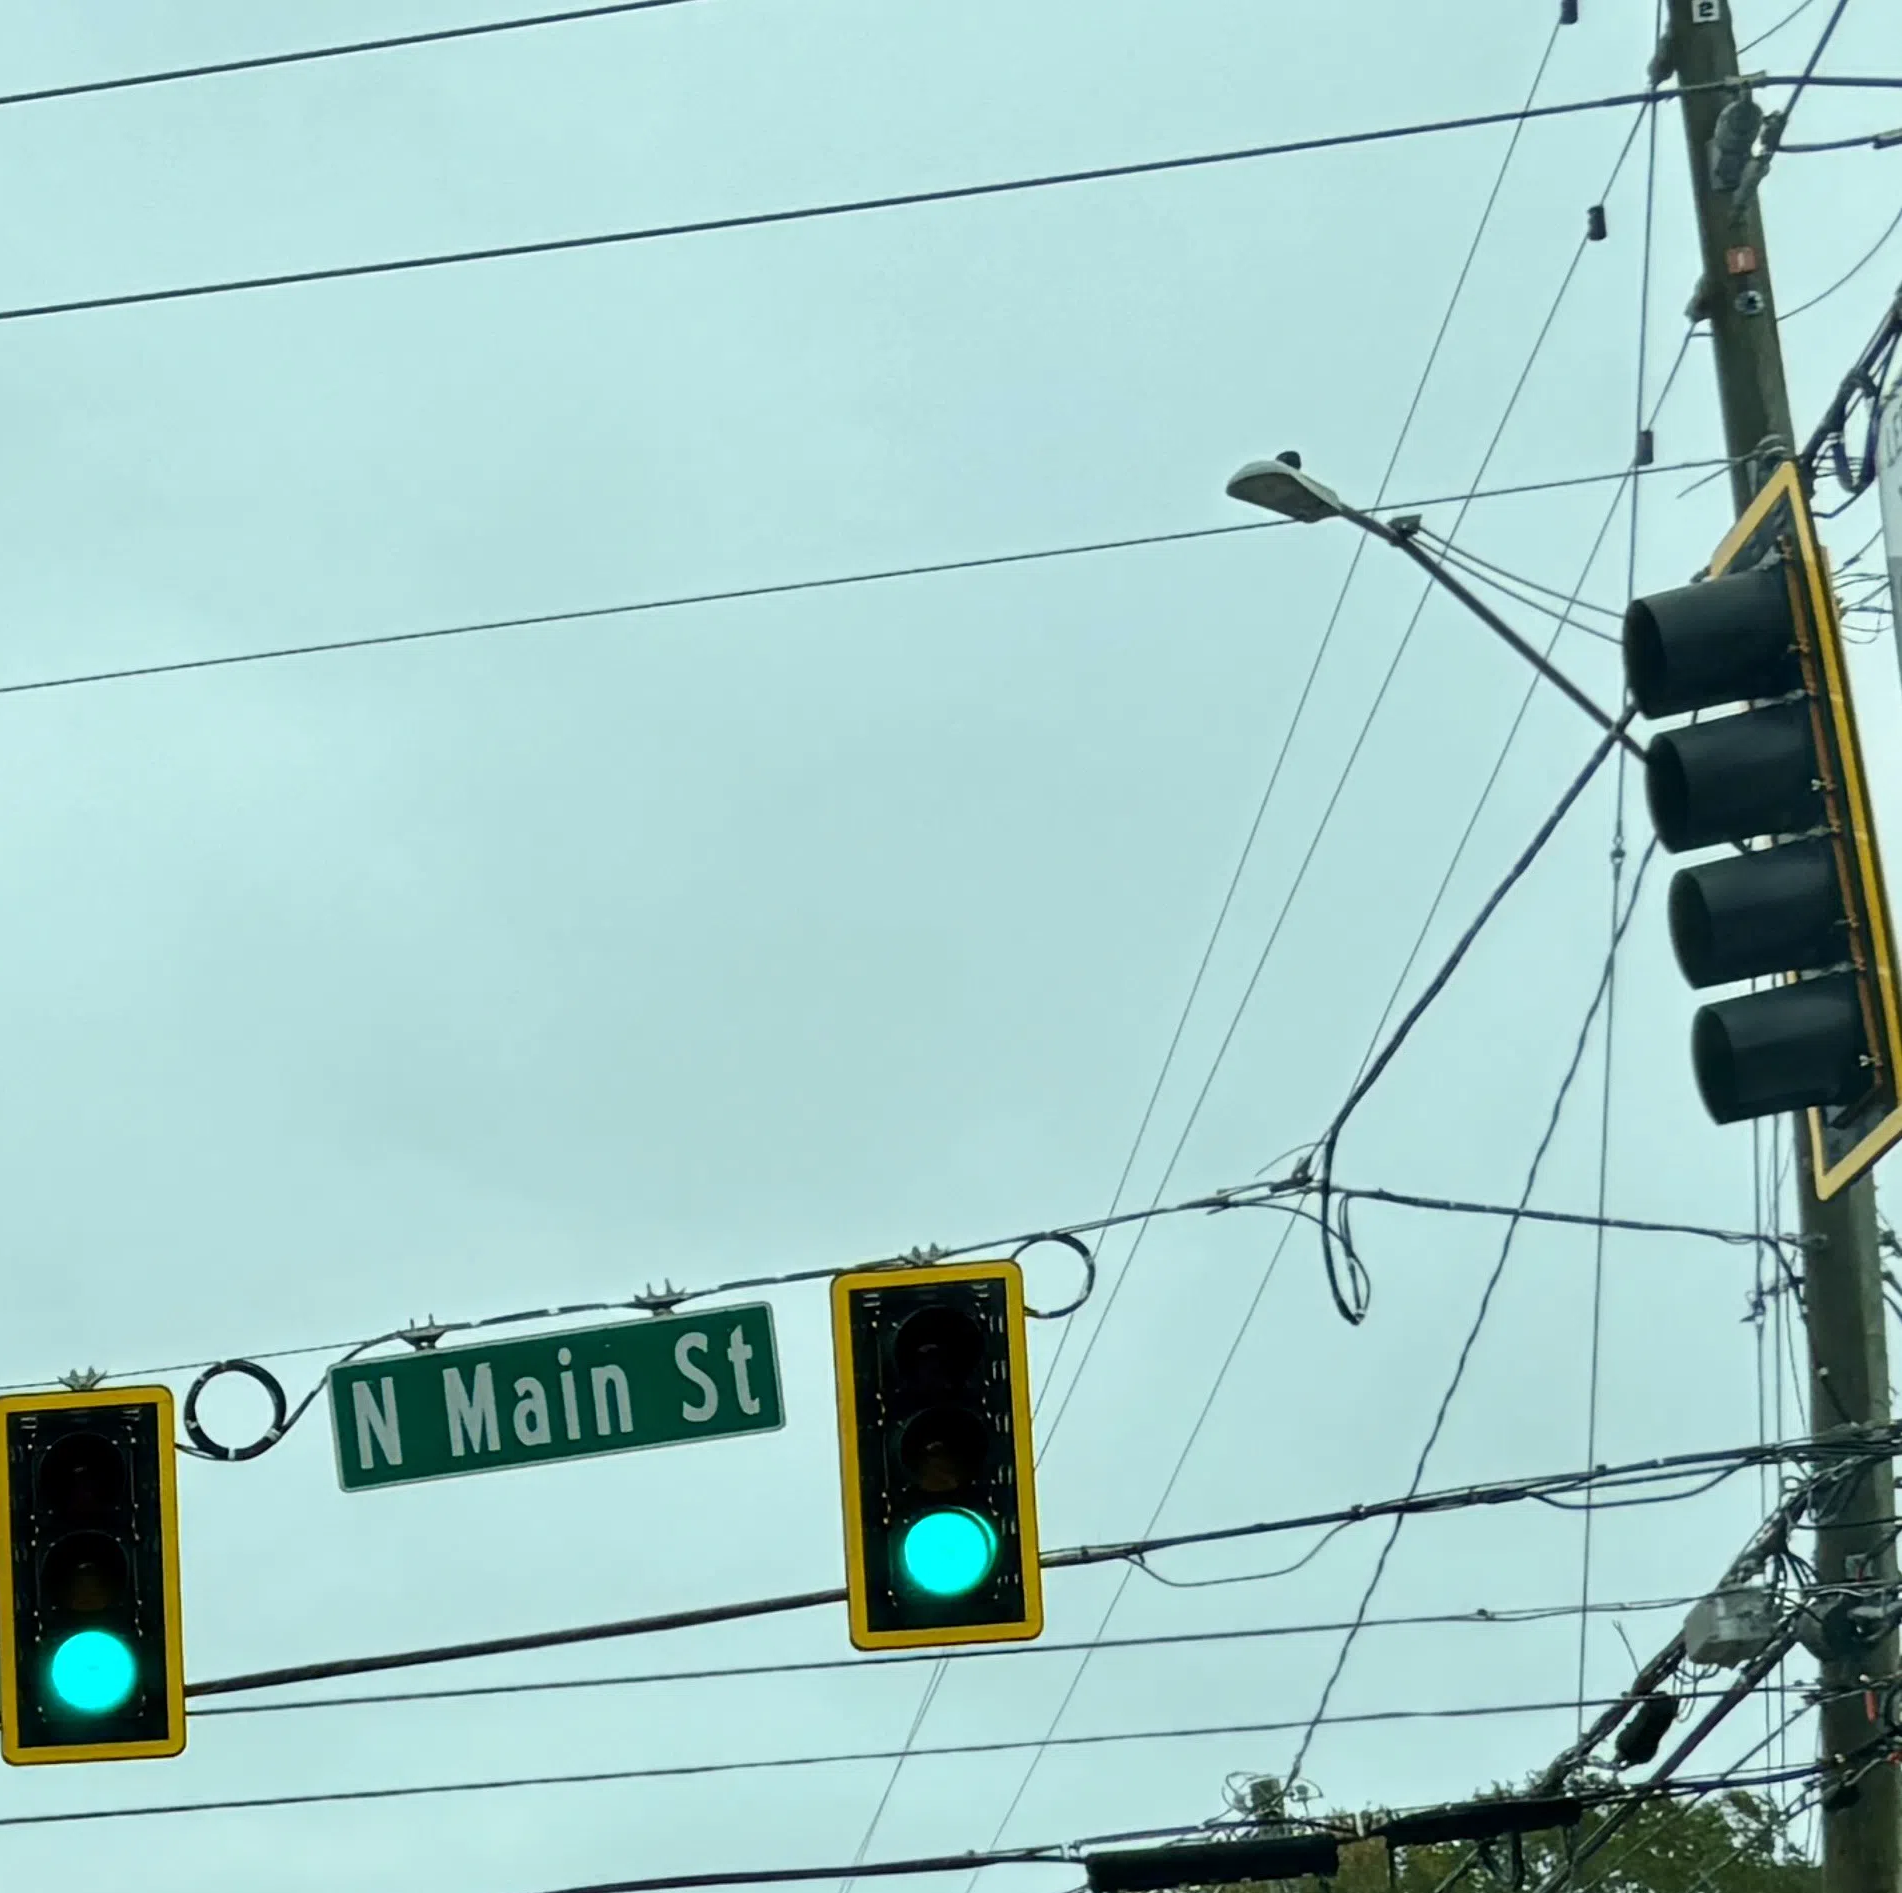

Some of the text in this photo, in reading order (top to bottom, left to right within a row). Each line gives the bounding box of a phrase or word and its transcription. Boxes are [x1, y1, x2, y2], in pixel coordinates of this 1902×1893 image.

[352, 1324, 760, 1470] N Main St
